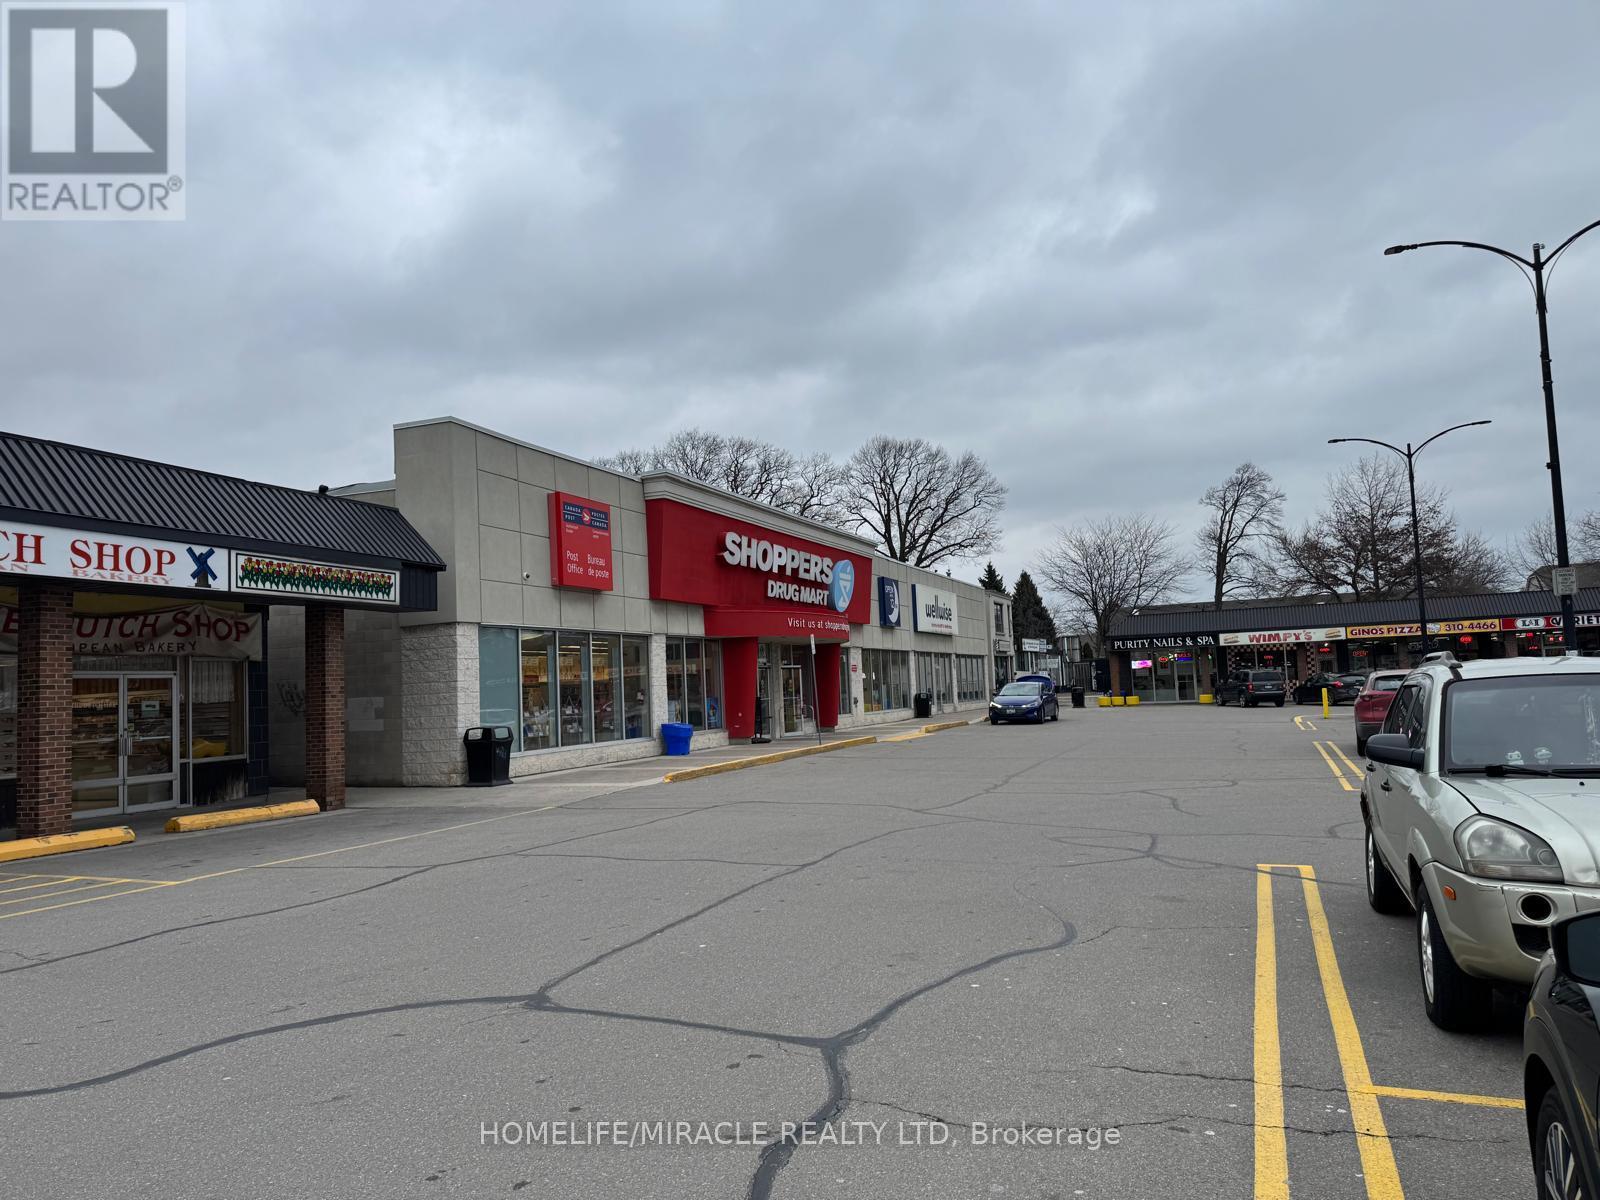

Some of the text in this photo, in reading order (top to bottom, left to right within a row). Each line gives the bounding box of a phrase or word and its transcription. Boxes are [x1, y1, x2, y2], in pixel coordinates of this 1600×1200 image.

[70, 539, 176, 576] SHOP
[566, 550, 579, 562] Post
[587, 554, 606, 566] Bureau
[723, 531, 834, 585] SHOPPERS
[567, 563, 584, 575] Office
[587, 566, 609, 579] de poste
[72, 569, 174, 585] BAKERY
[767, 579, 830, 606] DRUG MART
[925, 594, 952, 622] wellwise
[171, 610, 251, 643] SHOP
[787, 617, 806, 629] Visit
[807, 619, 816, 629] us
[817, 619, 824, 629] at
[1550, 614, 1600, 626] VRIET
[1350, 621, 1497, 636] GINOS PIZZA 310-4466
[1114, 635, 1215, 650] PURITY NAILS & SPA
[1247, 629, 1313, 644] WIMPY'S
[72, 640, 197, 654] PEAN BAKERY
